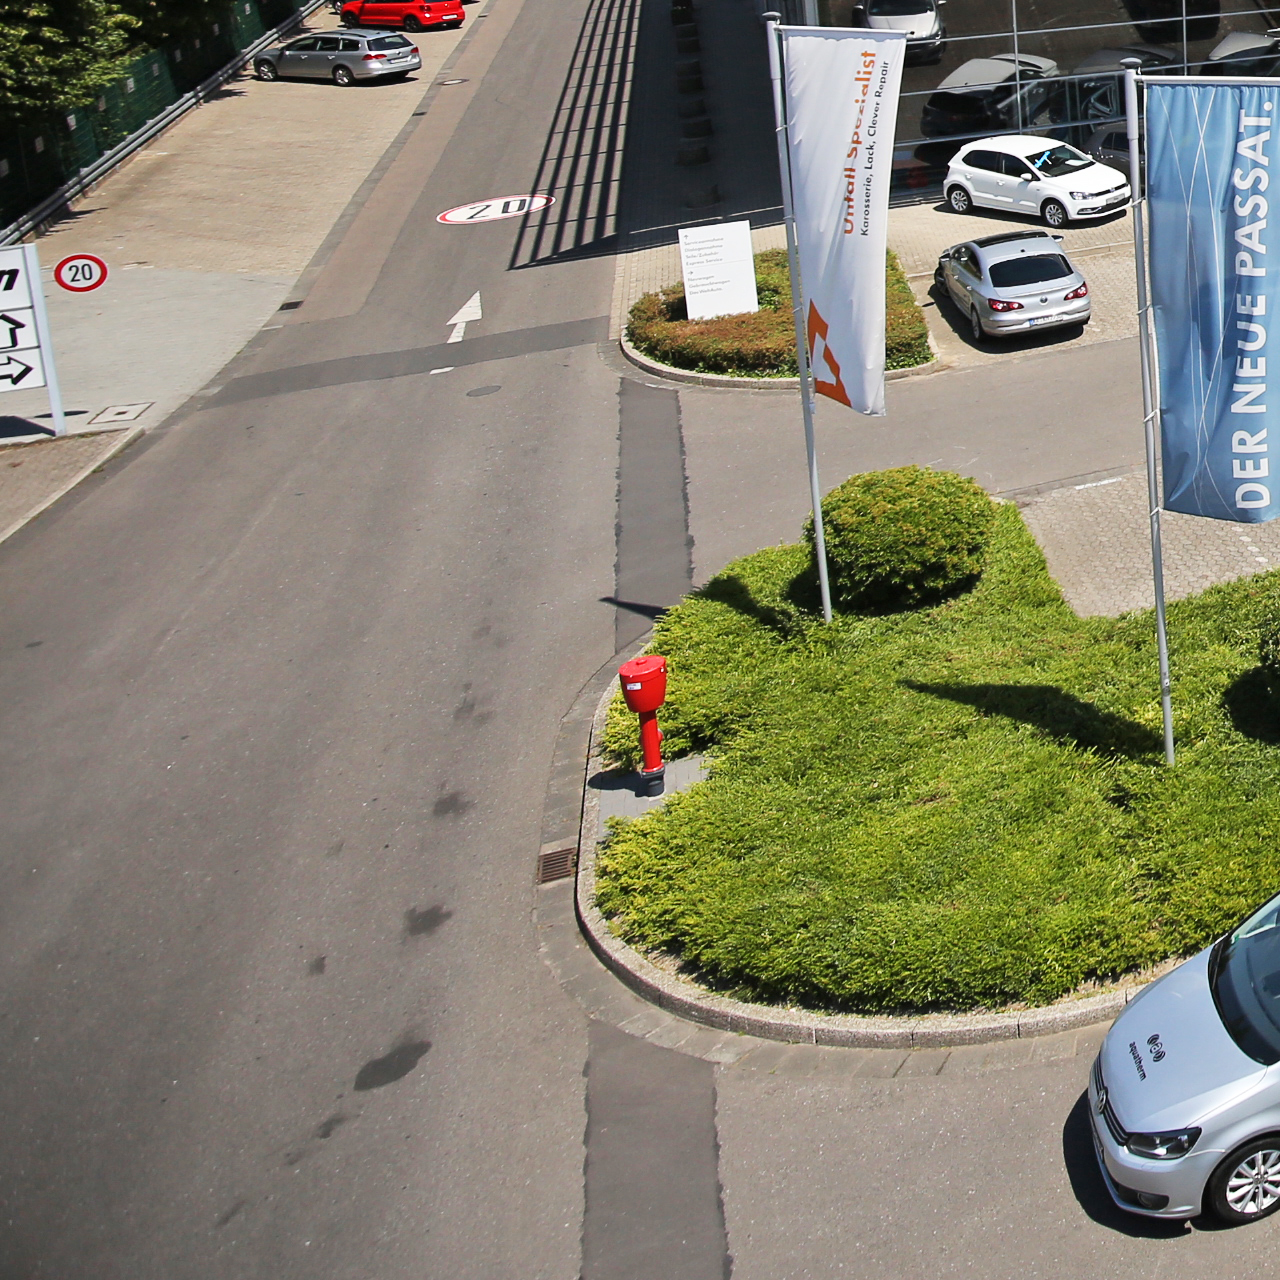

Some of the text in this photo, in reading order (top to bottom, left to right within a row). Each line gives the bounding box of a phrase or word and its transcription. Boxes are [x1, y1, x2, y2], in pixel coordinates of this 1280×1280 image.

[861, 60, 889, 236] Karosserie, Lack, Clever Repair
[467, 198, 527, 220] 20
[68, 263, 93, 282] 20
[1231, 101, 1274, 510] DER NEUE PASSAT.
[1129, 1041, 1147, 1081] aquatherm
